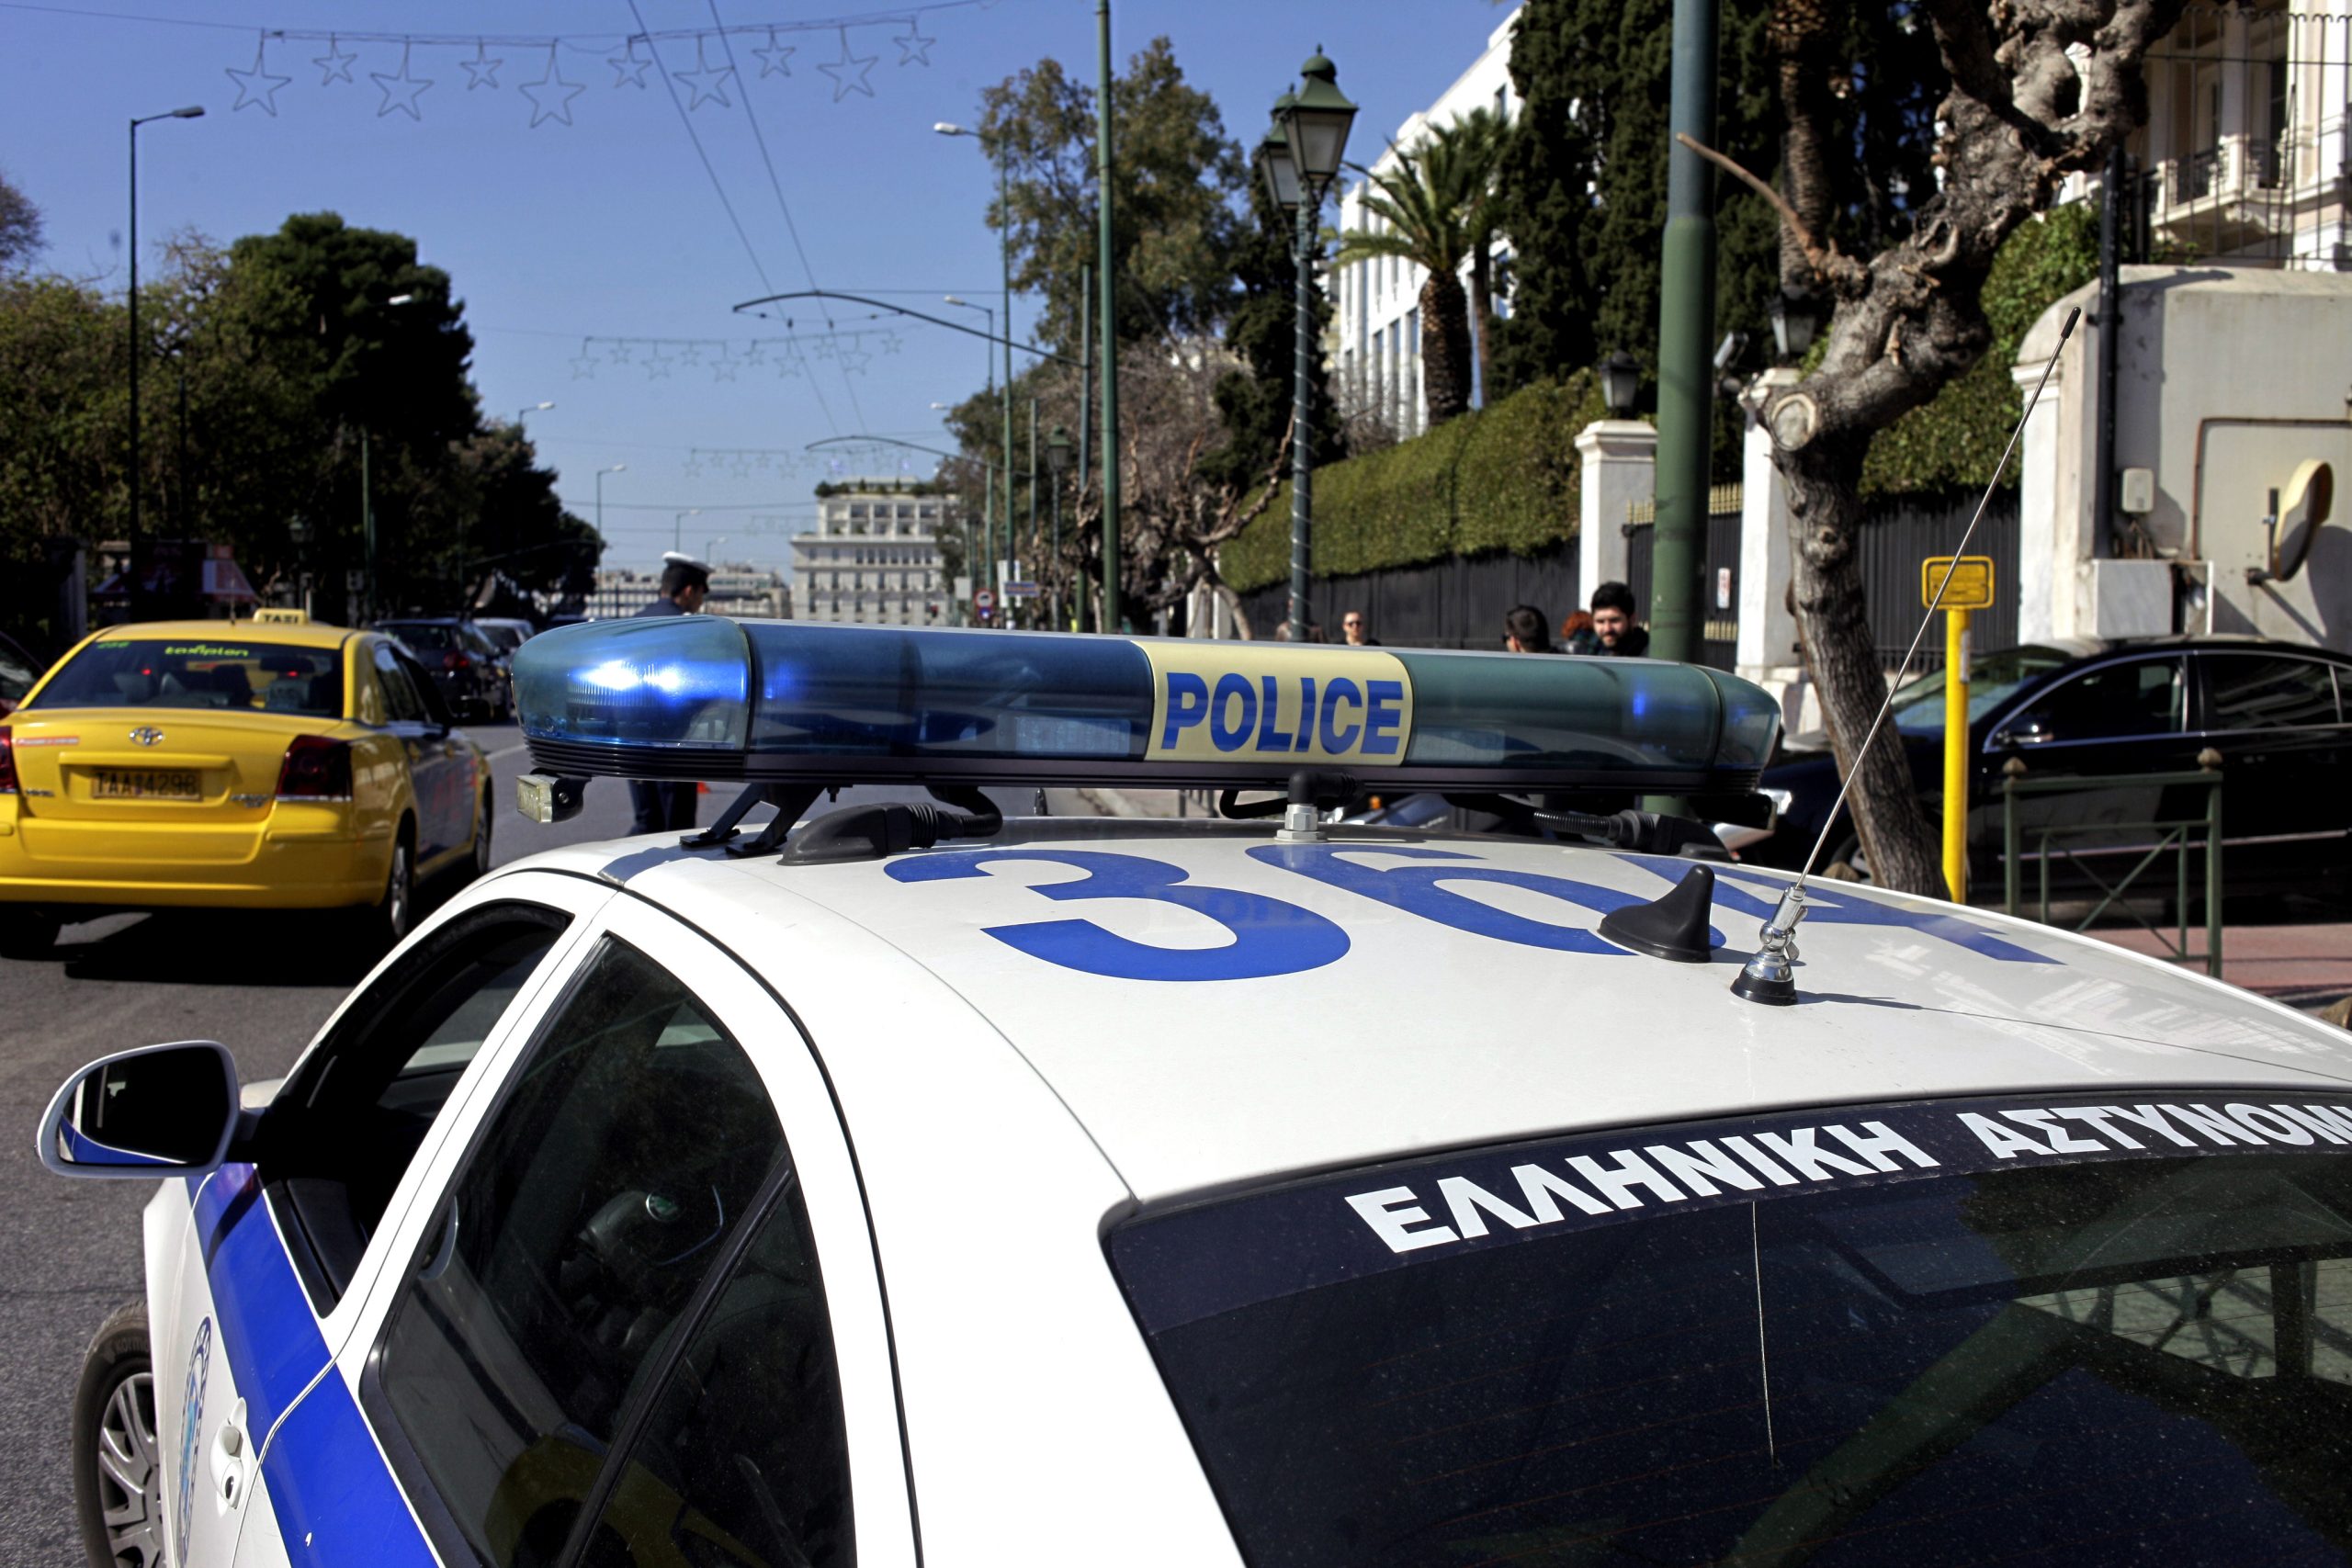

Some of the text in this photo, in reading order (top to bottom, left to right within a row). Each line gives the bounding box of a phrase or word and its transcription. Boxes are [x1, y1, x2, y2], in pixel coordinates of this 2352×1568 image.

[1160, 671, 1404, 755] POLICE
[1345, 1103, 2352, 1253] ΕΛΛΗΝΙΚΗ ΑΣΤΥΝΟΜ
